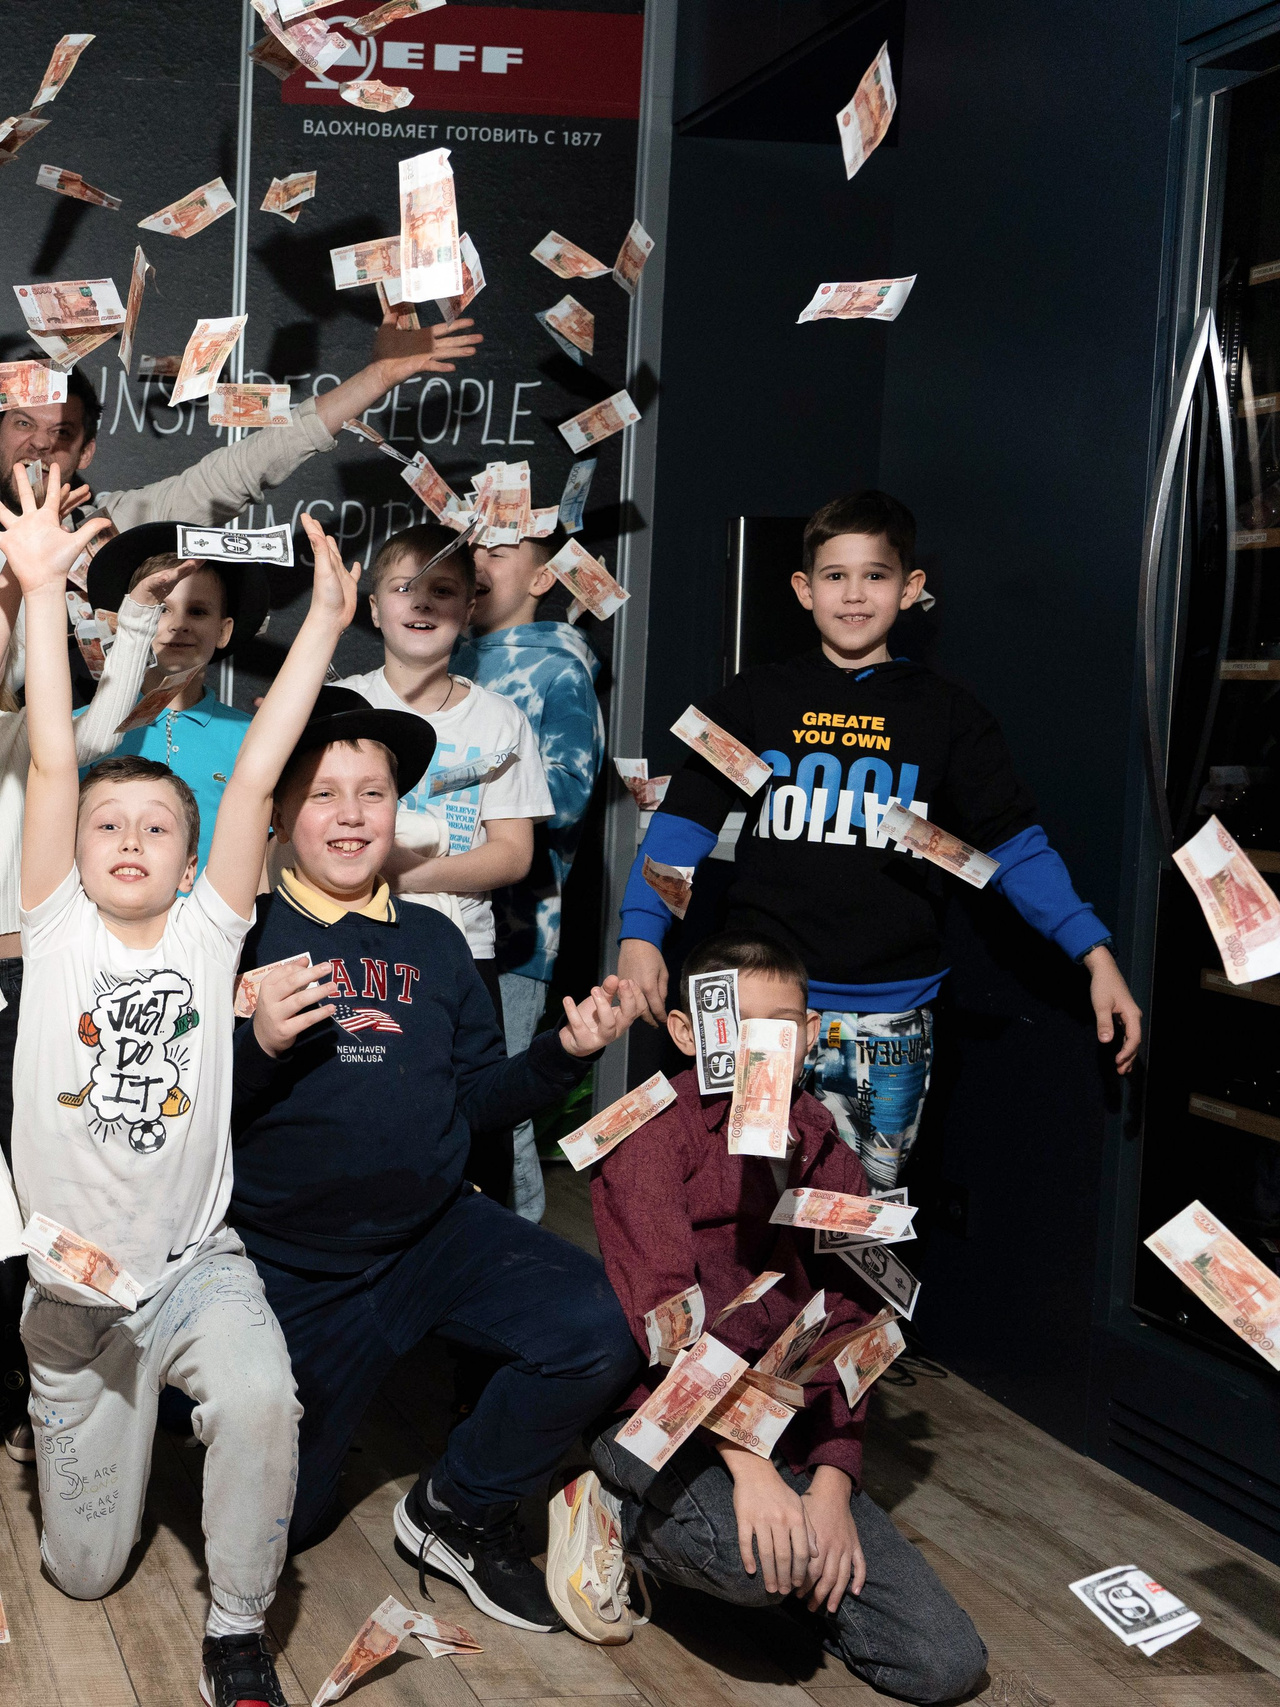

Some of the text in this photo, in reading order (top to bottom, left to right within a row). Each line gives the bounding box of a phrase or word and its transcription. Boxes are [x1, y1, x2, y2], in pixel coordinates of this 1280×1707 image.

[296, 47, 320, 71] 5000
[331, 39, 523, 74] NEFF
[303, 119, 602, 147] ВДОХНОВЛЯЕТ ГОТОВИТЬ С 1877
[802, 711, 886, 732] GREATE
[792, 729, 892, 751] YOU OWN
[725, 764, 750, 787] 5000
[446, 804, 477, 815] BELIEVE
[454, 813, 475, 823] YOUR
[1225, 933, 1250, 967] 5000
[328, 957, 421, 1004] ANT
[716, 1018, 727, 1044] Supreme
[829, 1026, 840, 1046] BLUE
[115, 1036, 154, 1071] DO
[336, 1045, 386, 1054] NEW HAVEN
[340, 1054, 384, 1063] CONN.USA
[102, 1073, 164, 1113] IT
[731, 1103, 746, 1139] 5000
[1233, 1316, 1275, 1351] 5000
[704, 1373, 732, 1402] 5000
[40, 1436, 77, 1454] ST.
[729, 1427, 760, 1448] 5000
[93, 1463, 117, 1479] ARE
[74, 1489, 120, 1515] WE ARE
[86, 1502, 116, 1522] FREE
